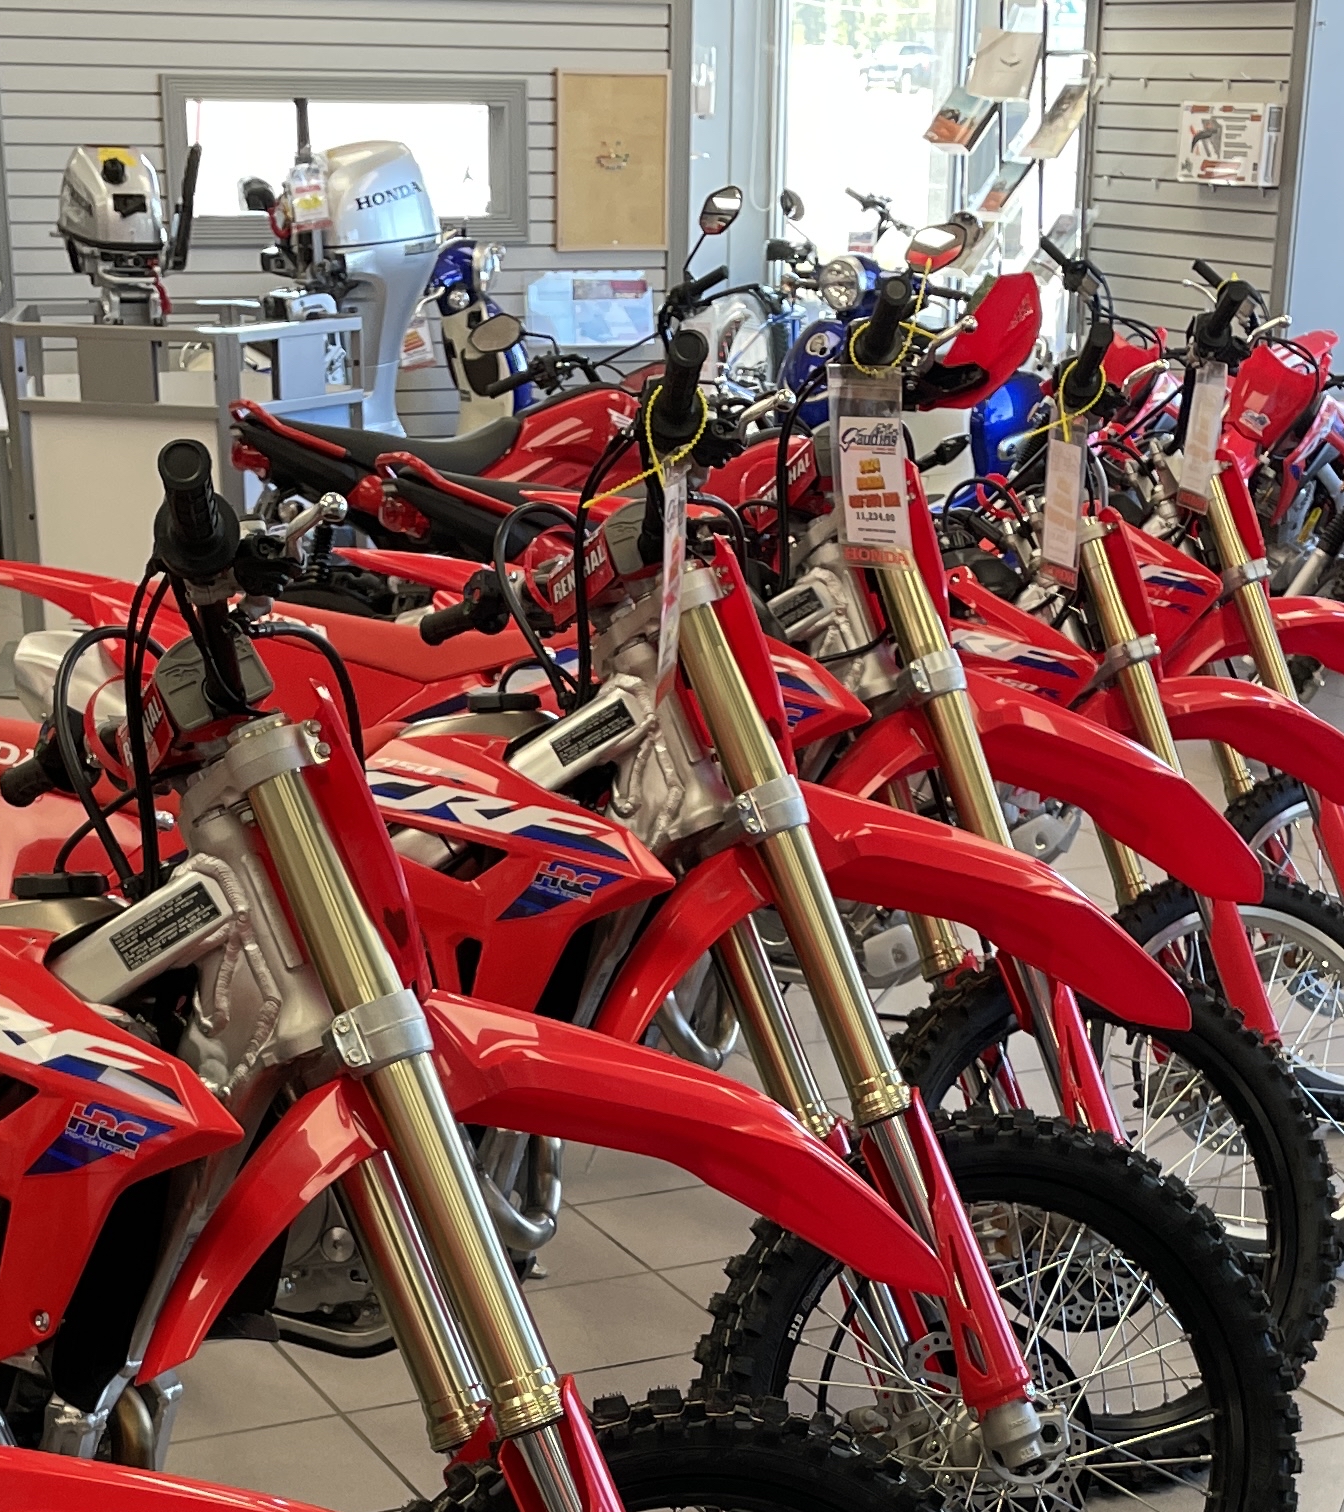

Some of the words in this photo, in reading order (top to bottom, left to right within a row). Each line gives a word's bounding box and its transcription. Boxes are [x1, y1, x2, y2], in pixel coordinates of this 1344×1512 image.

[355, 180, 423, 212] HONDA
[760, 452, 811, 514] RHAL
[552, 541, 606, 604] RENHAL
[366, 770, 616, 836] CRF
[67, 1101, 150, 1151] HRC
